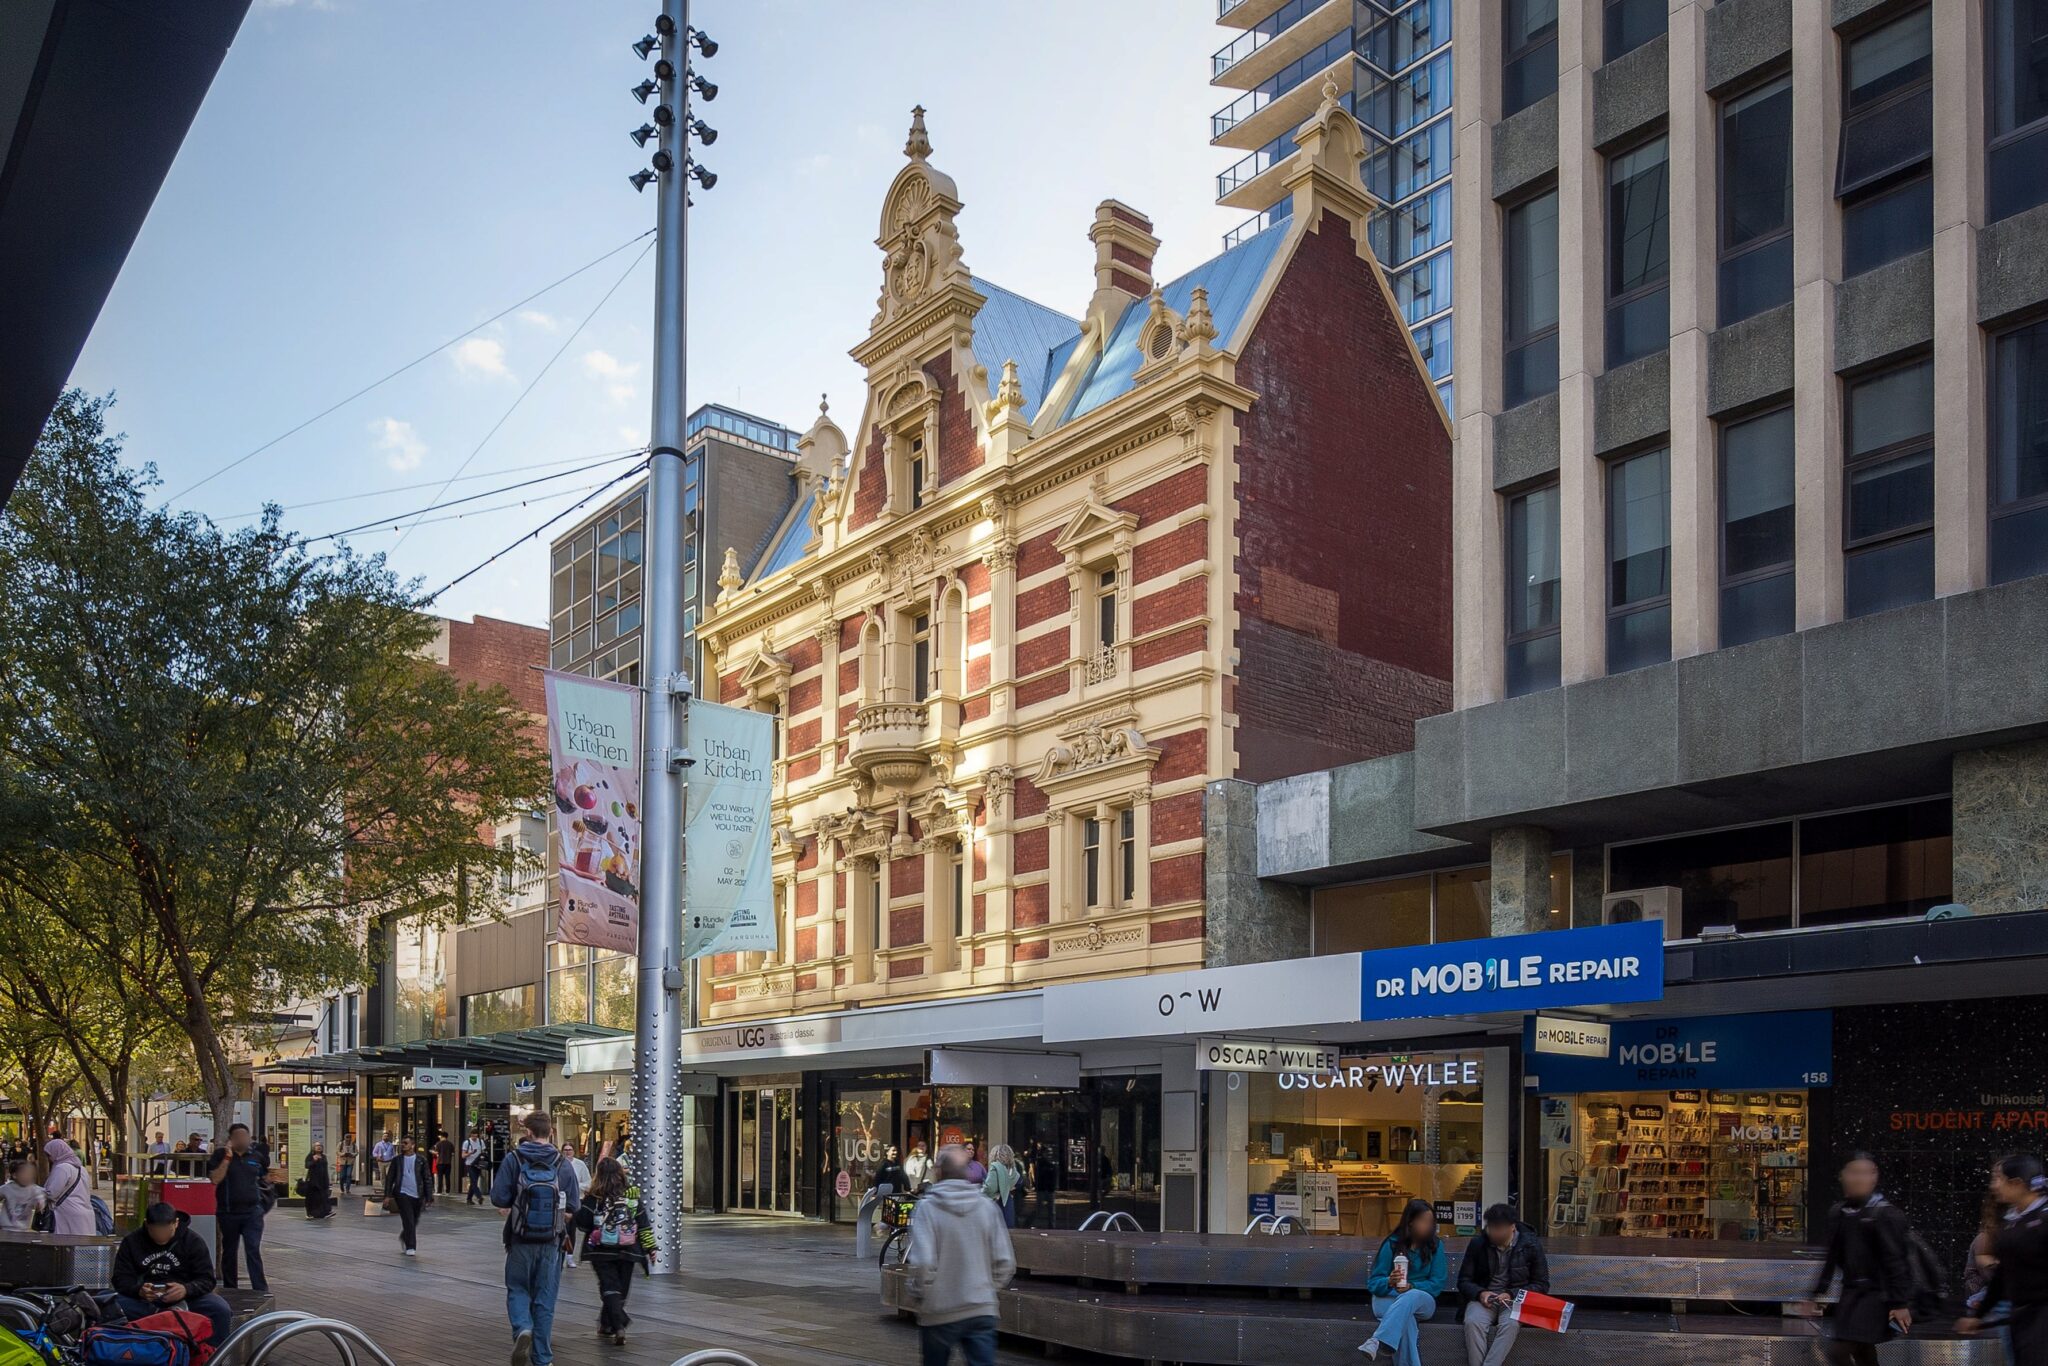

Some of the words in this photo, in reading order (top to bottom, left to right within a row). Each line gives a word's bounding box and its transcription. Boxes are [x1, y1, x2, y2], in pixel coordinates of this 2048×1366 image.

[565, 711, 616, 739] Urban
[568, 731, 629, 762] Kitchen
[704, 739, 751, 763] Urban
[704, 758, 763, 782] Kitchen
[711, 803, 728, 811] YOU
[715, 823, 732, 831] YOU
[723, 867, 734, 876] 02
[717, 877, 734, 885] MAY
[1376, 979, 1404, 998] DR
[1410, 956, 1542, 996] MOBILE
[1549, 956, 1640, 984] REPAIR
[701, 1035, 733, 1048] ORIGINAL
[736, 1028, 765, 1048] UGG
[795, 1027, 815, 1039] classic
[1538, 1030, 1548, 1040] DR
[1548, 1030, 1585, 1045] MOBILE
[1585, 1035, 1608, 1046] REPAIR
[1208, 1046, 1268, 1066] OSCAR
[1279, 1050, 1335, 1069] WYLEE
[1619, 1041, 1717, 1066] MOBILE
[1382, 1061, 1478, 1087] WYLEE
[1637, 1067, 1697, 1082] REPAIR
[1801, 1072, 1828, 1084] 158
[302, 1085, 321, 1094] Foot
[323, 1086, 354, 1095] Locker
[1981, 1094, 2046, 1106] Unihouse
[1890, 1111, 1984, 1130] STUDENT
[945, 1135, 960, 1143] UGG
[1730, 1125, 1803, 1140] MOBILE
[844, 1138, 881, 1162] UGG
